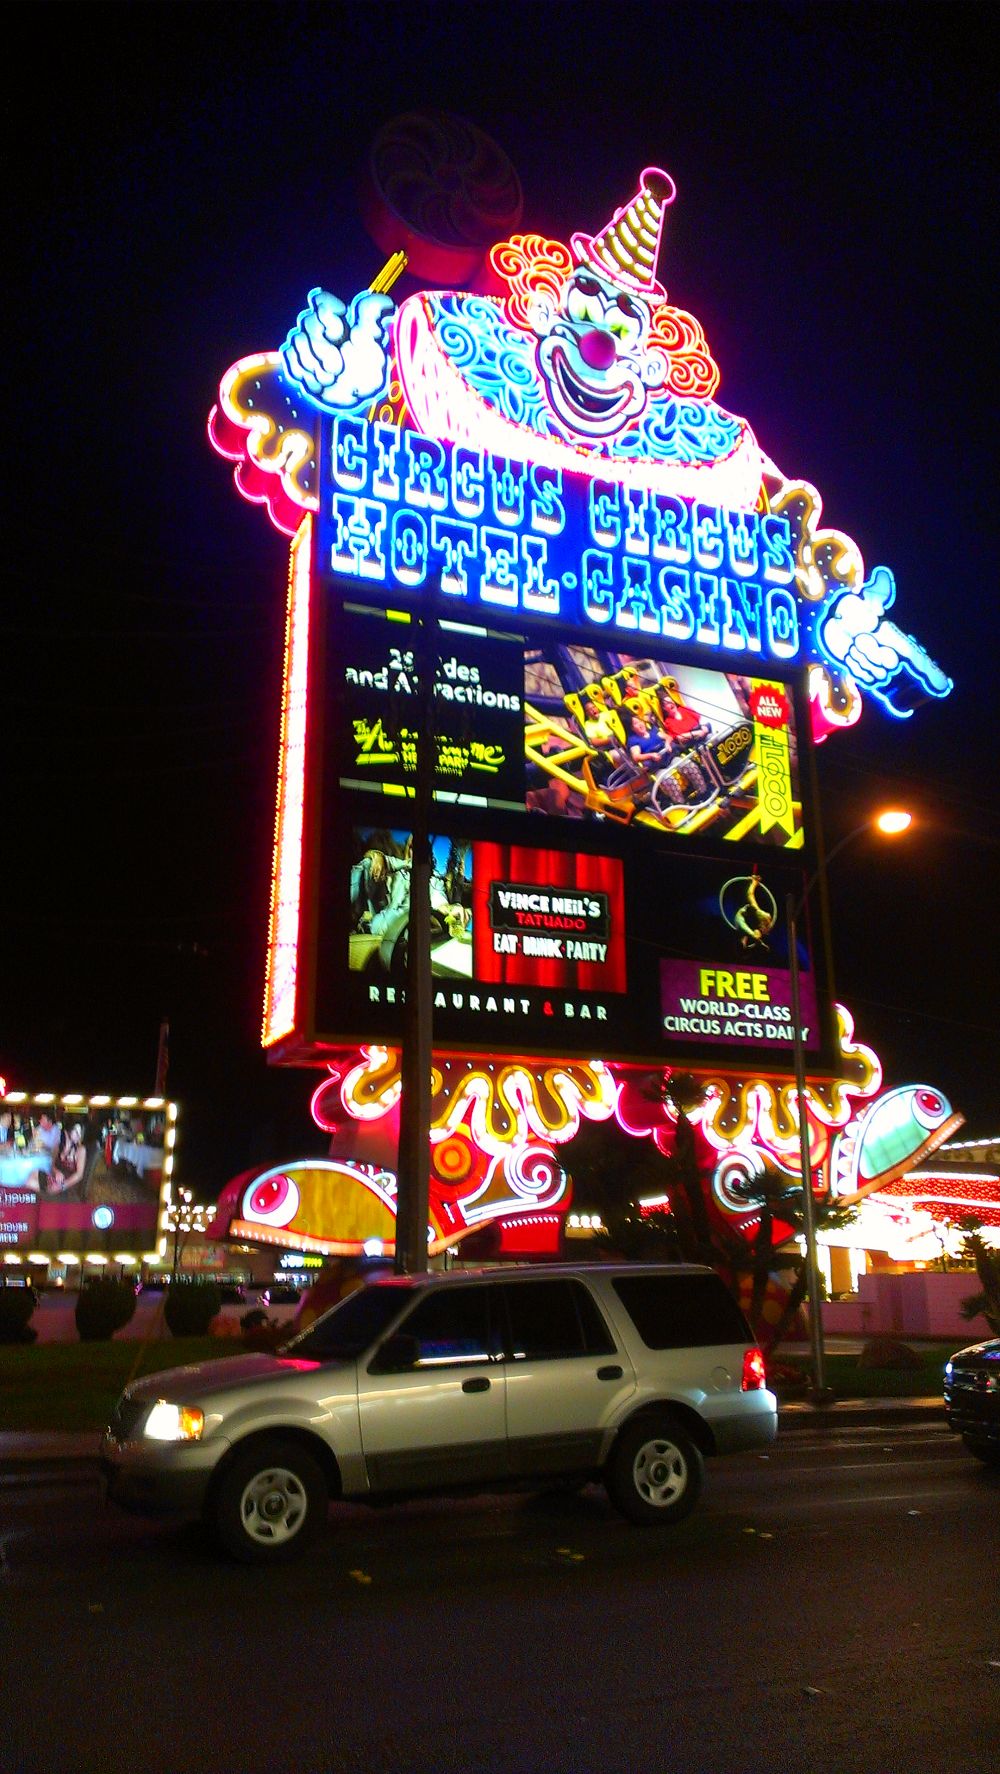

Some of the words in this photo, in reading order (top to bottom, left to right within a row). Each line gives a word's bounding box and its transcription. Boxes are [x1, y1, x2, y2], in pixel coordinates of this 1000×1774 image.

[332, 415, 566, 536] CIRCUS
[589, 477, 795, 585] CIRCUS
[331, 492, 561, 614] HOTEL
[582, 548, 800, 659] CASINO
[345, 666, 389, 691] and
[394, 671, 521, 712] Aractions
[759, 695, 778, 707] ALL
[757, 706, 783, 718] NEW
[497, 890, 550, 912] VINCE
[551, 897, 601, 918] NEIL'S
[515, 911, 587, 932] TATUADO
[493, 932, 519, 955] EAT
[566, 940, 608, 963] PARTY
[699, 968, 771, 1002] FREE
[368, 985, 531, 1015] REAURANT
[542, 1001, 554, 1017] &
[564, 1002, 608, 1021] BAR
[679, 998, 792, 1022] WORLD-CLASS
[663, 1015, 721, 1036] CIRCUS
[723, 1020, 764, 1039] ACTS
